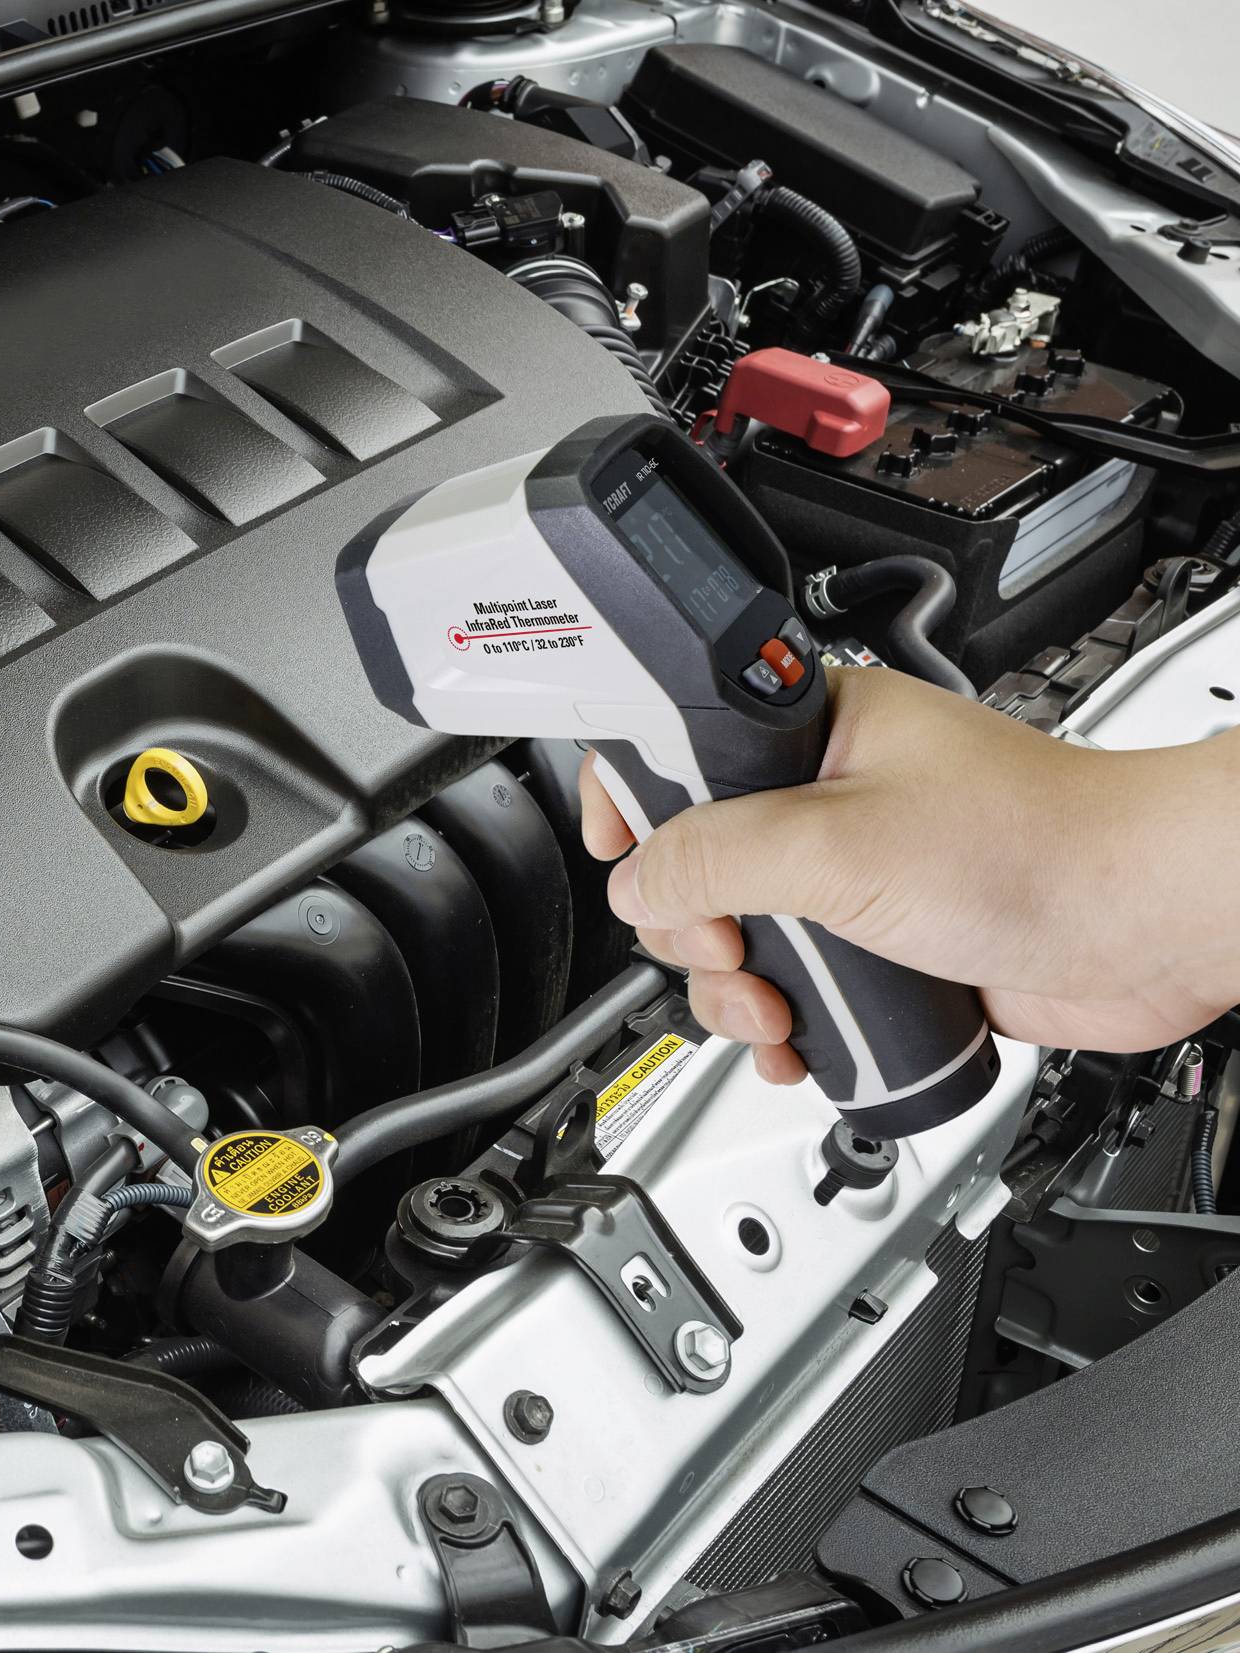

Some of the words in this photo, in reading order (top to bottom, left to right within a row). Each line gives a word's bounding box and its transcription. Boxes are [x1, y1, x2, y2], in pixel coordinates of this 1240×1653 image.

[603, 481, 633, 514] TCRAFT
[465, 616, 511, 632] InfraRed
[510, 612, 579, 629] Thermometer
[473, 599, 528, 616] Multipoint
[528, 598, 558, 611] Laser
[483, 643, 491, 654] 0
[492, 643, 502, 654] to
[503, 640, 530, 653] 110°C
[535, 639, 548, 650] 32
[548, 638, 558, 649] to
[559, 635, 584, 648] 230°F
[632, 1039, 679, 1080] CAUTION
[229, 1139, 273, 1171] CAUTION
[249, 1172, 267, 1187] OPEN
[266, 1159, 285, 1175] WHEN
[264, 1172, 305, 1203] ENGINE
[267, 1174, 316, 1212] COOLANT
